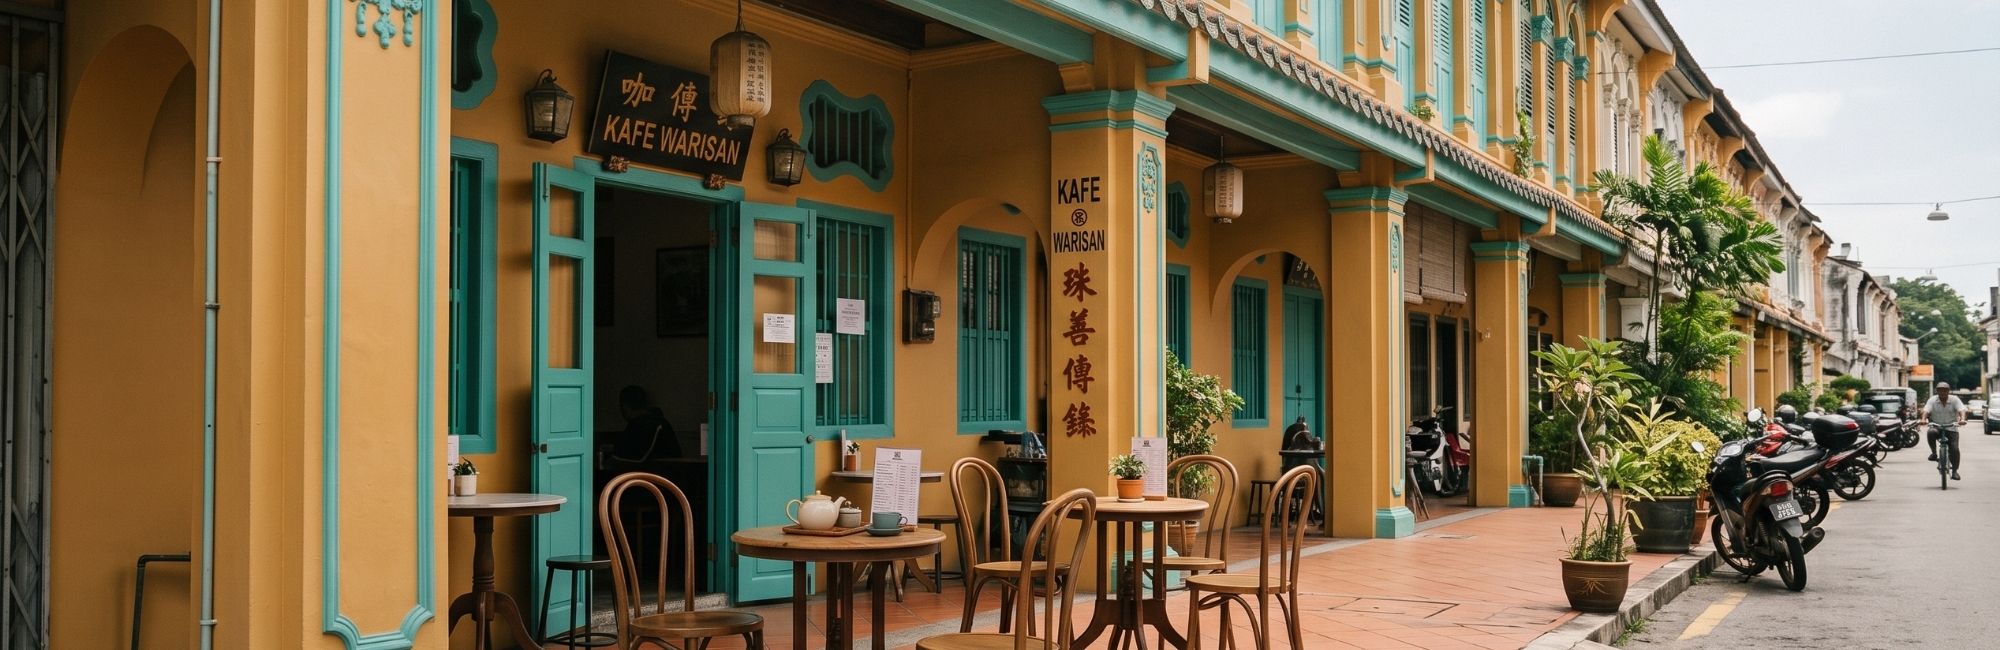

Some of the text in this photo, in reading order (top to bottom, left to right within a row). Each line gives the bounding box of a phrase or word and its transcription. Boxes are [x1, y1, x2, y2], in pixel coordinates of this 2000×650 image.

[604, 114, 741, 166] KAFE WARISAN
[1058, 177, 1100, 204] KAFE
[1053, 230, 1105, 253] WARISAN
